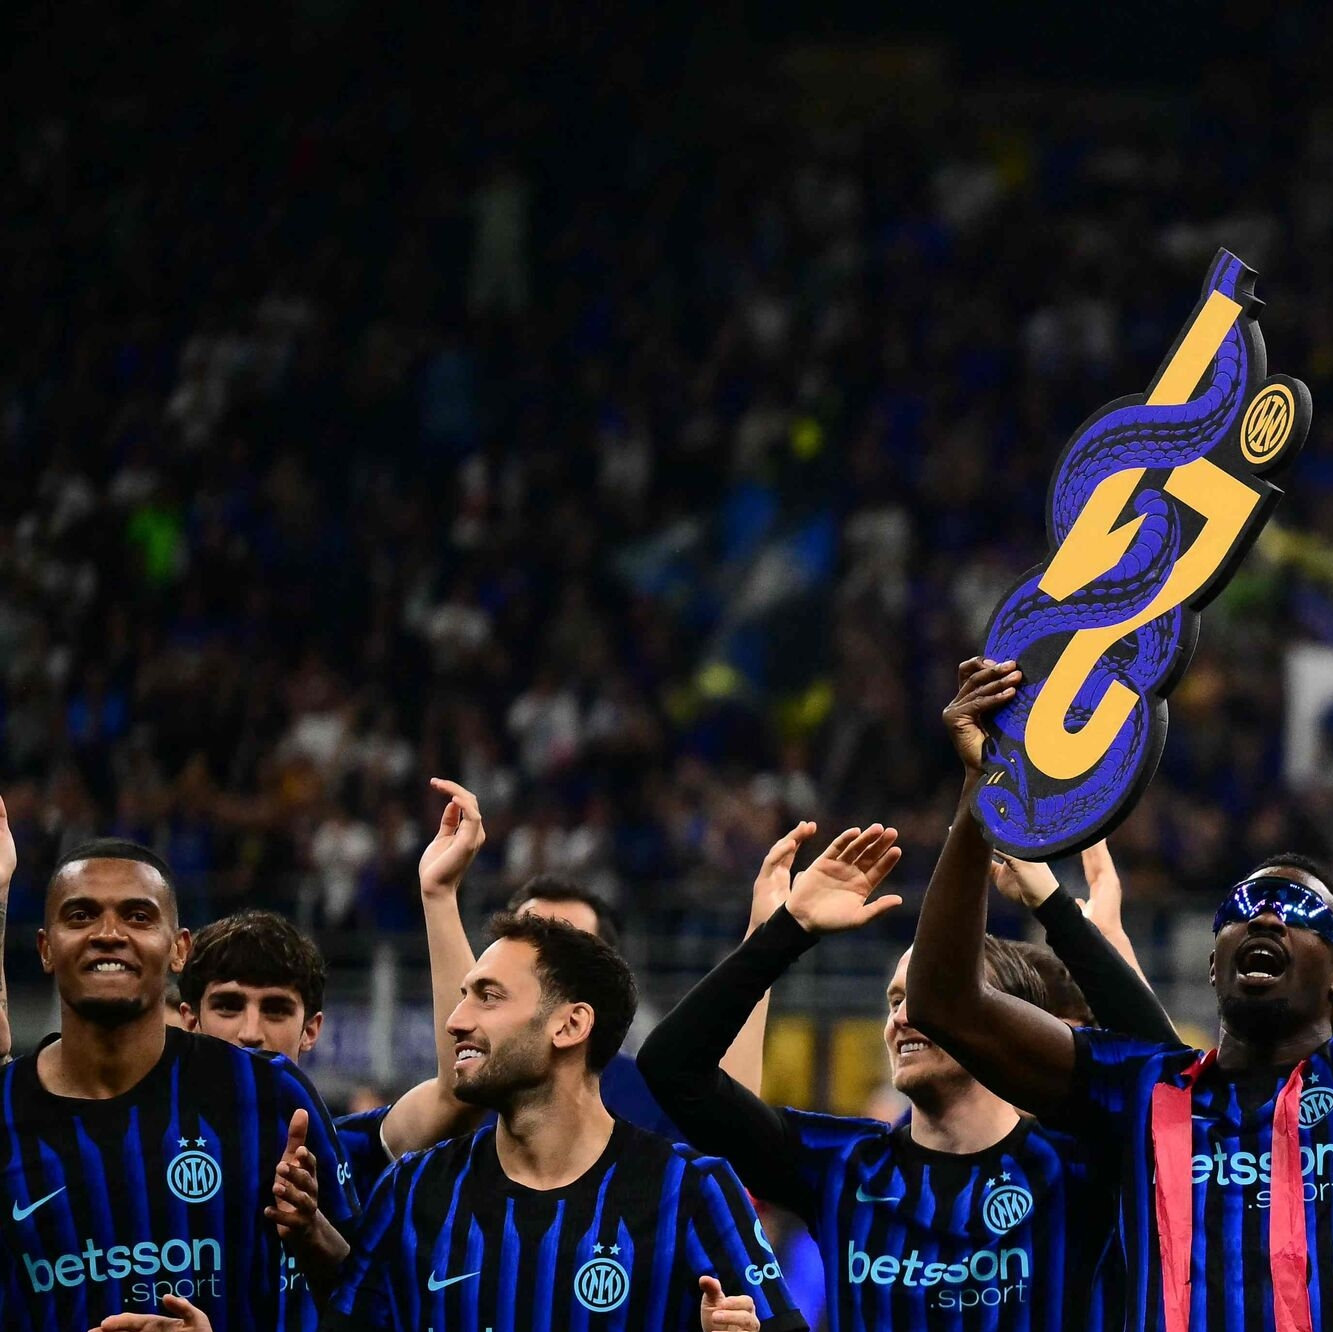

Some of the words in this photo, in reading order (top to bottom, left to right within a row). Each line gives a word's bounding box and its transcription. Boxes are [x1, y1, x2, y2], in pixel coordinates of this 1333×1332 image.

[24, 1238, 221, 1294] betsson
[848, 1240, 1029, 1287] betsson
[931, 1280, 1028, 1310] .sport
